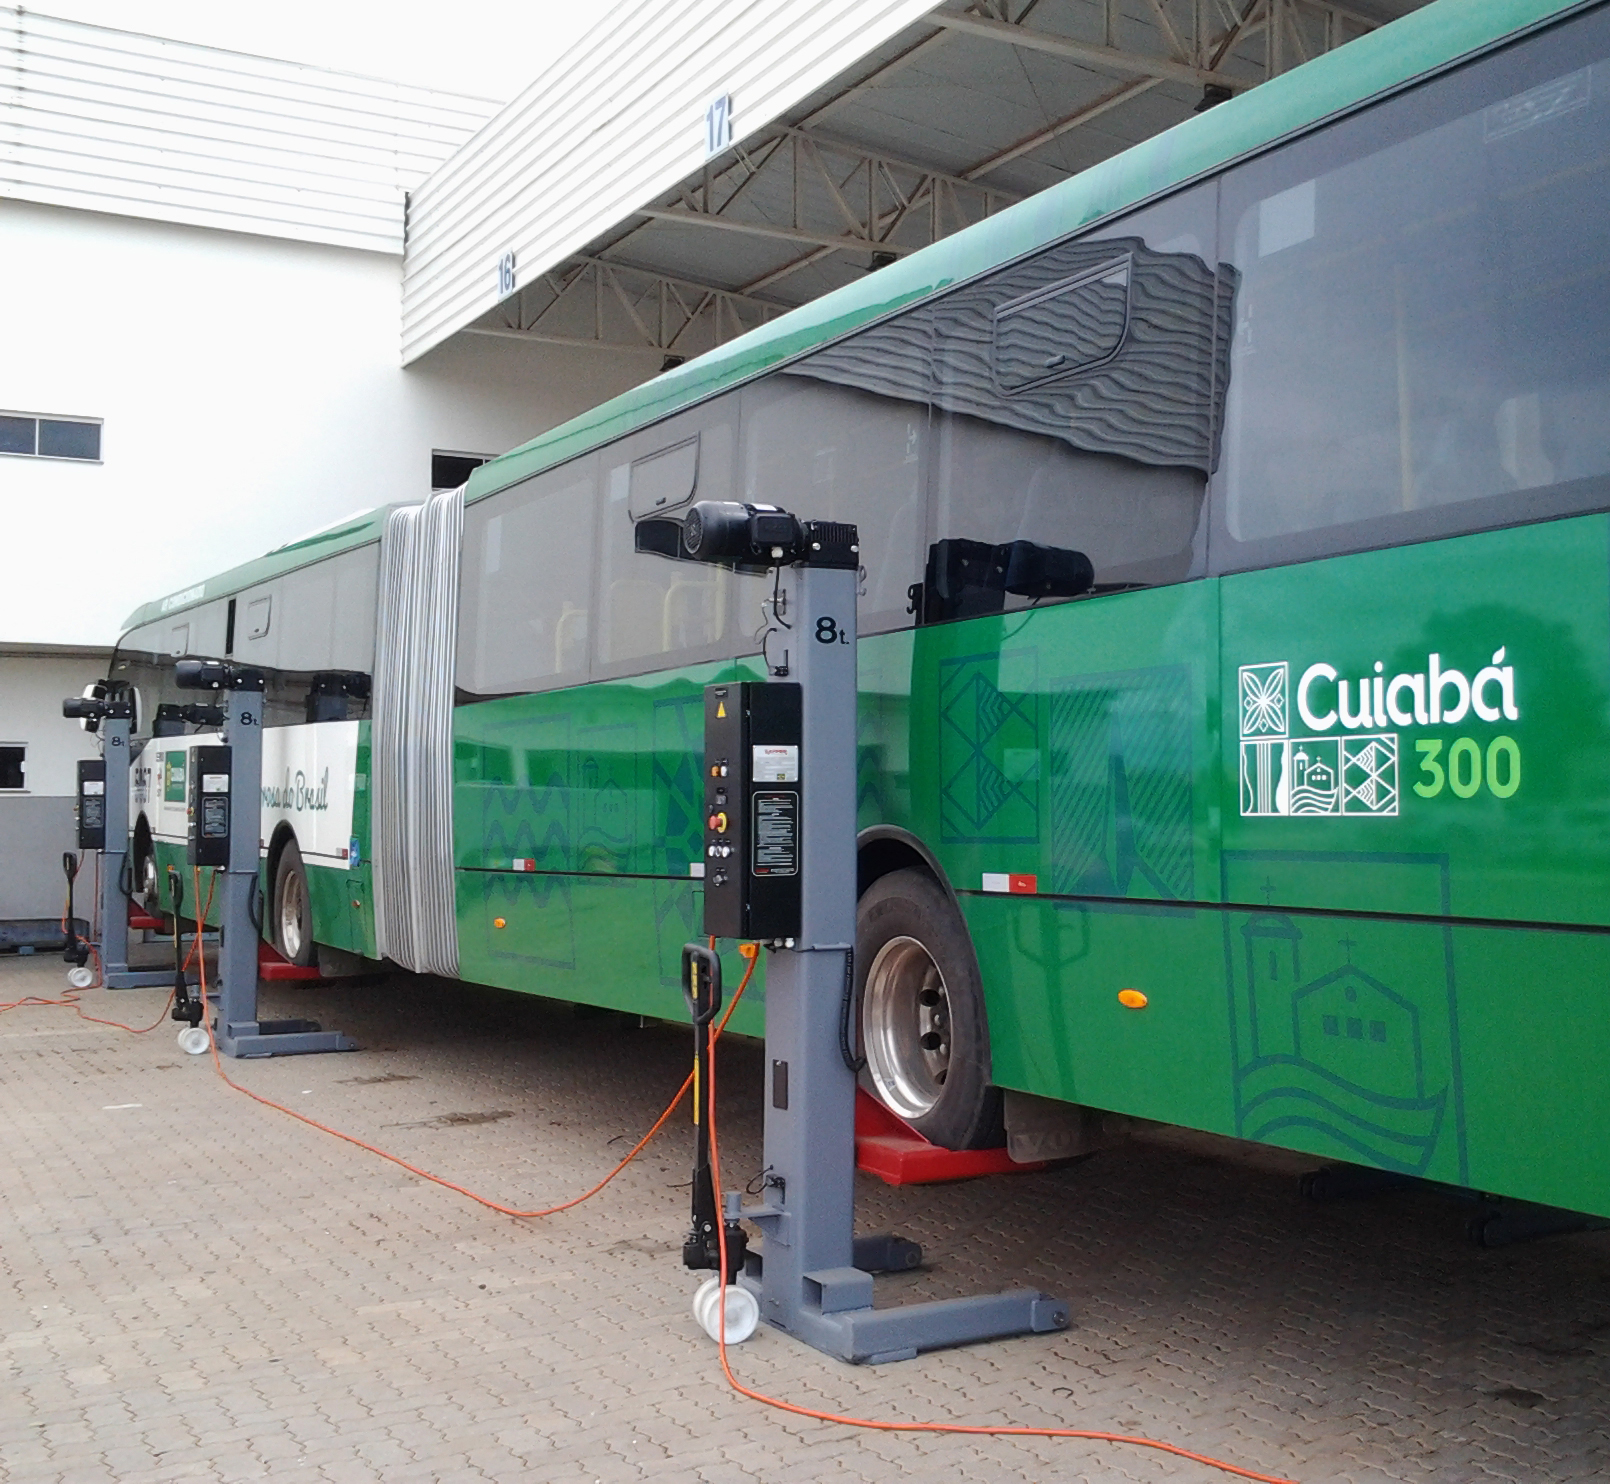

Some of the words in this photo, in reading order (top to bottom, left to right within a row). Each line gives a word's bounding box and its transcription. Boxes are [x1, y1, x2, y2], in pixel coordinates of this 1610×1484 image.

[706, 95, 727, 152] 17
[498, 253, 511, 294] 16
[1297, 645, 1519, 731] Cuiabá
[295, 766, 329, 812] Brasil
[1412, 735, 1521, 799] 300
